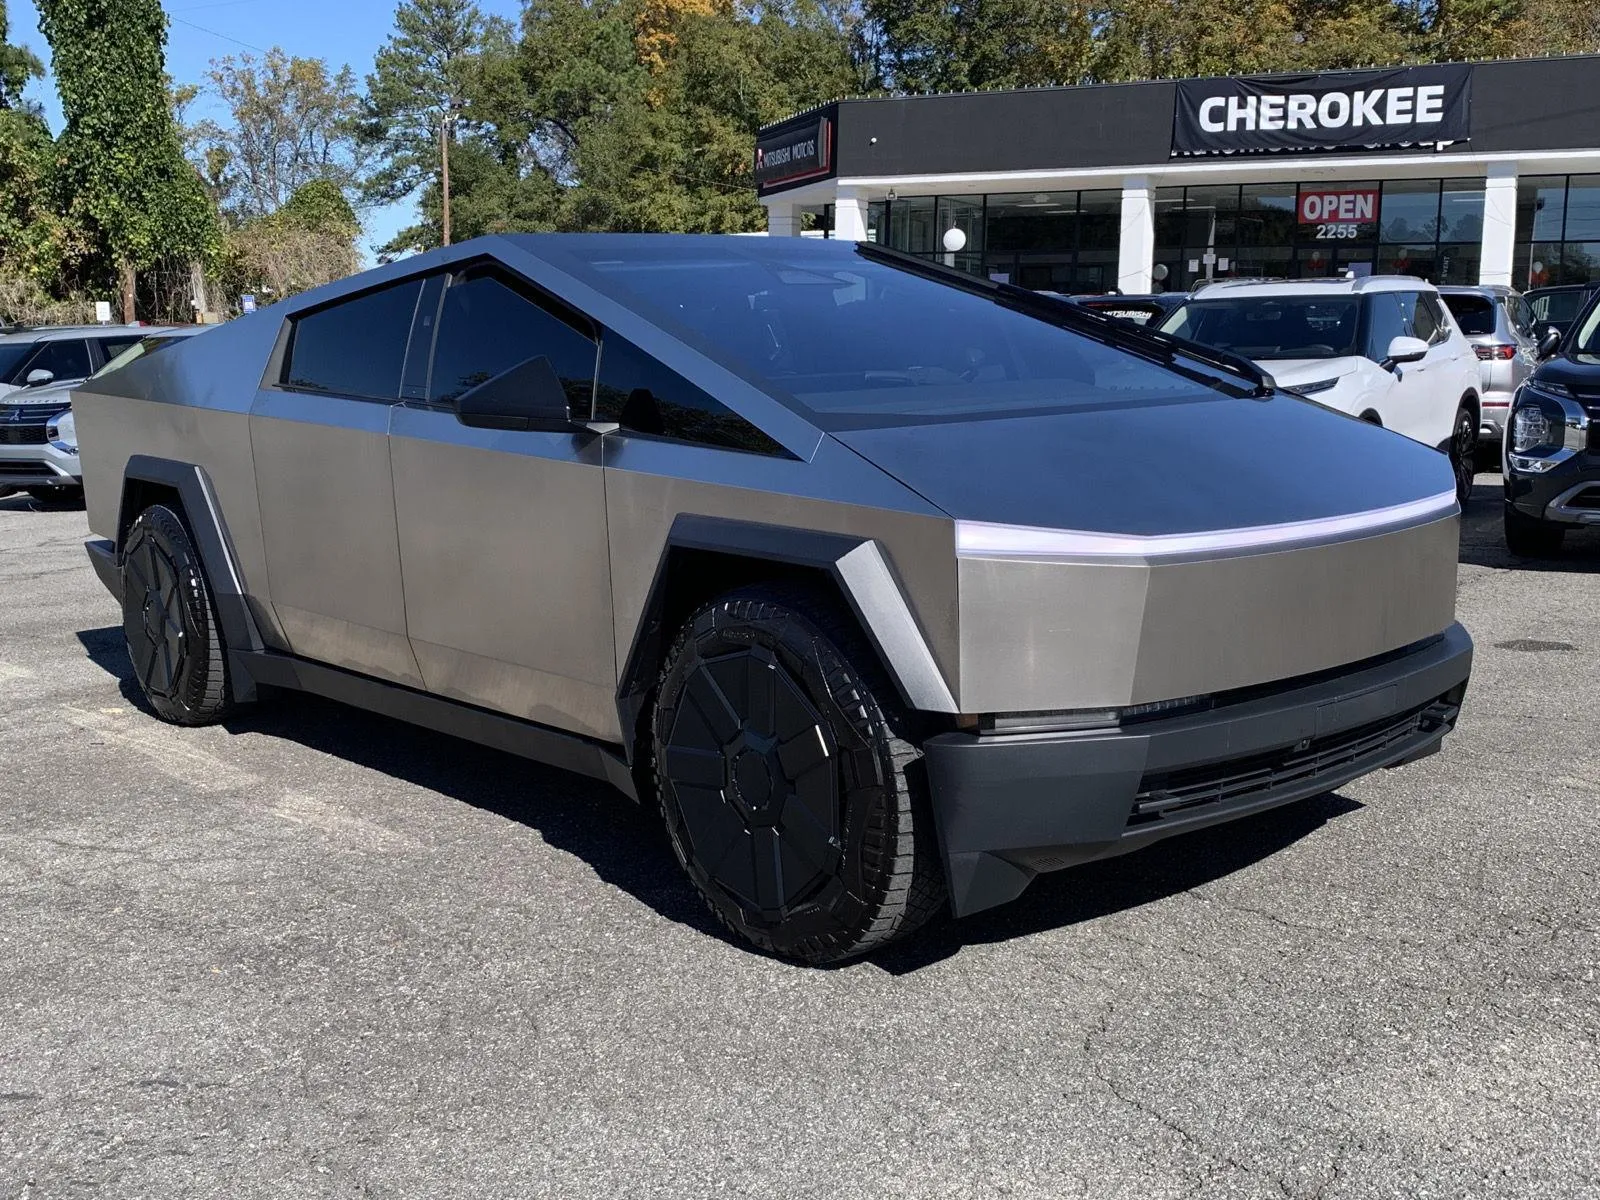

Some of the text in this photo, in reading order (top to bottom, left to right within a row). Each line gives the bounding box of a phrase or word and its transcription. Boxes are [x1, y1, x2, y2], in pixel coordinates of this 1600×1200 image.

[1199, 85, 1445, 133] CHEROKEE
[1303, 193, 1373, 220] OPEN
[1315, 224, 1357, 239] 2255
